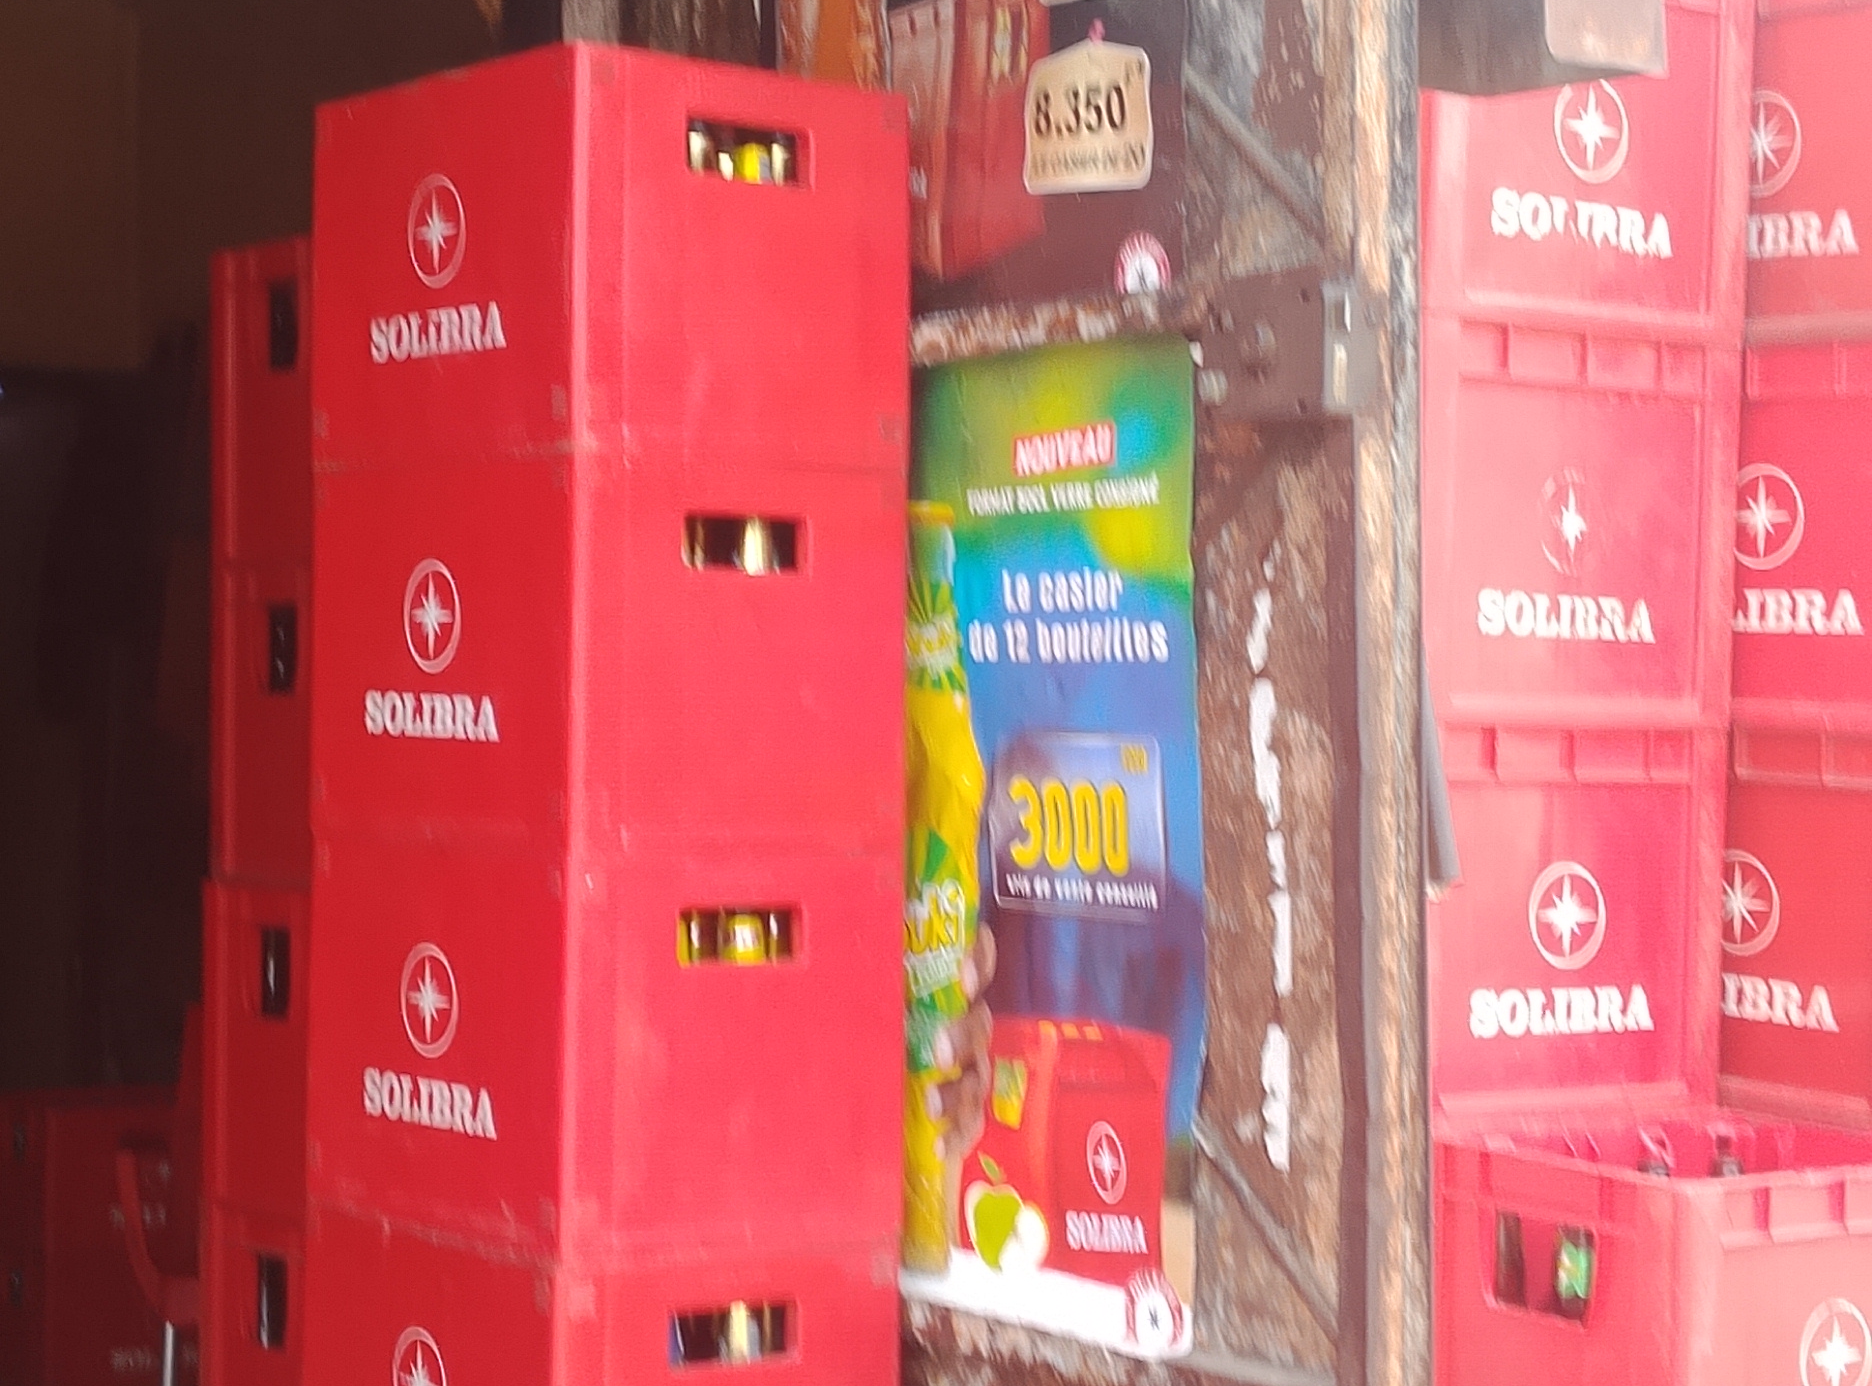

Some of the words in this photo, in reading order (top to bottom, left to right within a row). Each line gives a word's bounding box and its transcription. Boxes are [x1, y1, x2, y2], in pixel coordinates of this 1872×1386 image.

[1034, 82, 1126, 140] 8.350
[1490, 187, 1673, 260] SOLIBRA
[370, 300, 507, 363] SOLIBRA
[1015, 423, 1113, 477] NOUVEAU
[1002, 568, 1031, 613] Le
[1038, 565, 1123, 613] casier
[1477, 587, 1656, 644] SOLIBRA
[968, 618, 998, 663] de
[1003, 617, 1030, 664] 12
[1035, 616, 1169, 664] bouteilles
[364, 688, 500, 743] SOLIBRA
[1008, 773, 1130, 877] 3000
[1468, 984, 1655, 1039] SOLIBRA
[363, 1066, 497, 1141] SOLIBRA
